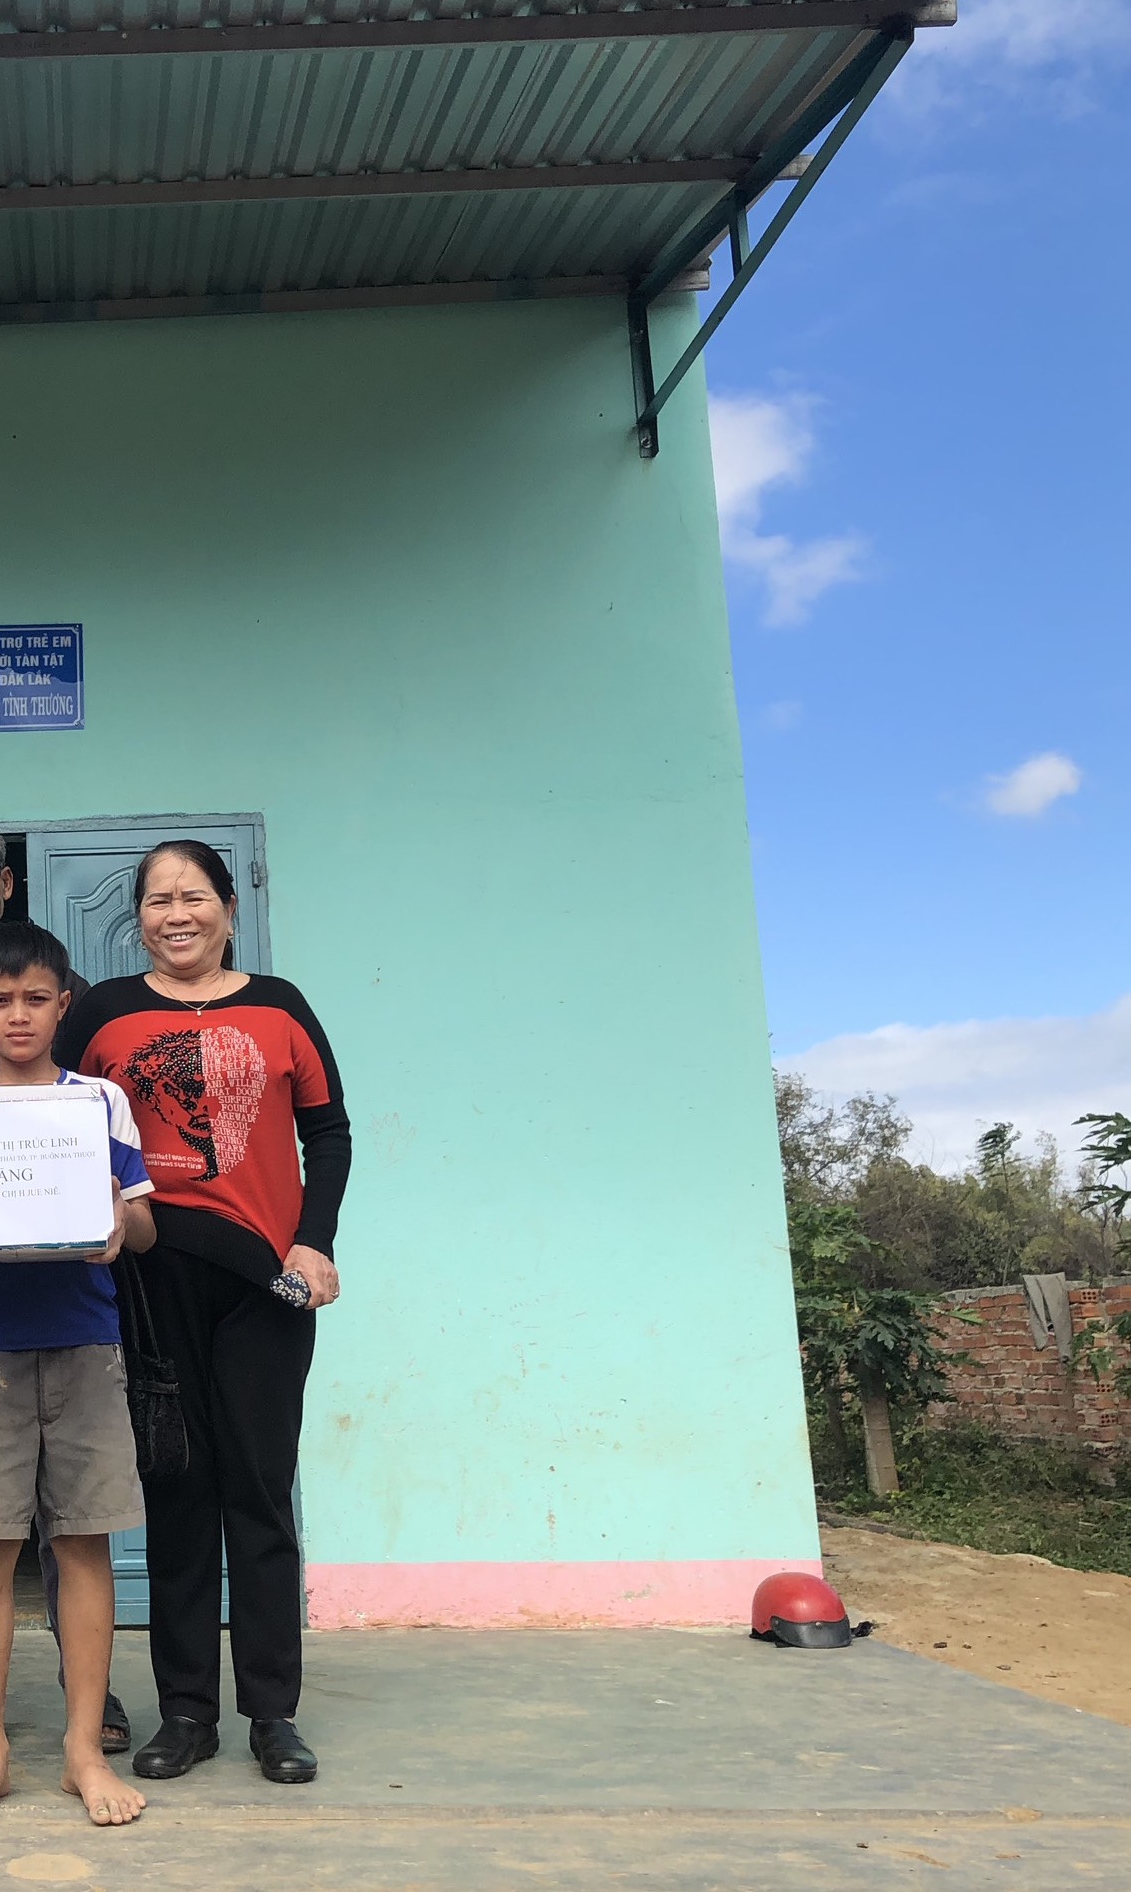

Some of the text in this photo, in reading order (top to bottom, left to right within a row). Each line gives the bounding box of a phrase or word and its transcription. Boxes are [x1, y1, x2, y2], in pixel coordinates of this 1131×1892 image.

[0, 636, 23, 650] TRỢ
[26, 633, 49, 648] TRẺ
[52, 636, 72, 648] EM
[15, 653, 39, 667] TÀN
[2, 691, 28, 717] TÌNH
[30, 692, 74, 716] THƯƠNG
[51, 1137, 78, 1148] LINH
